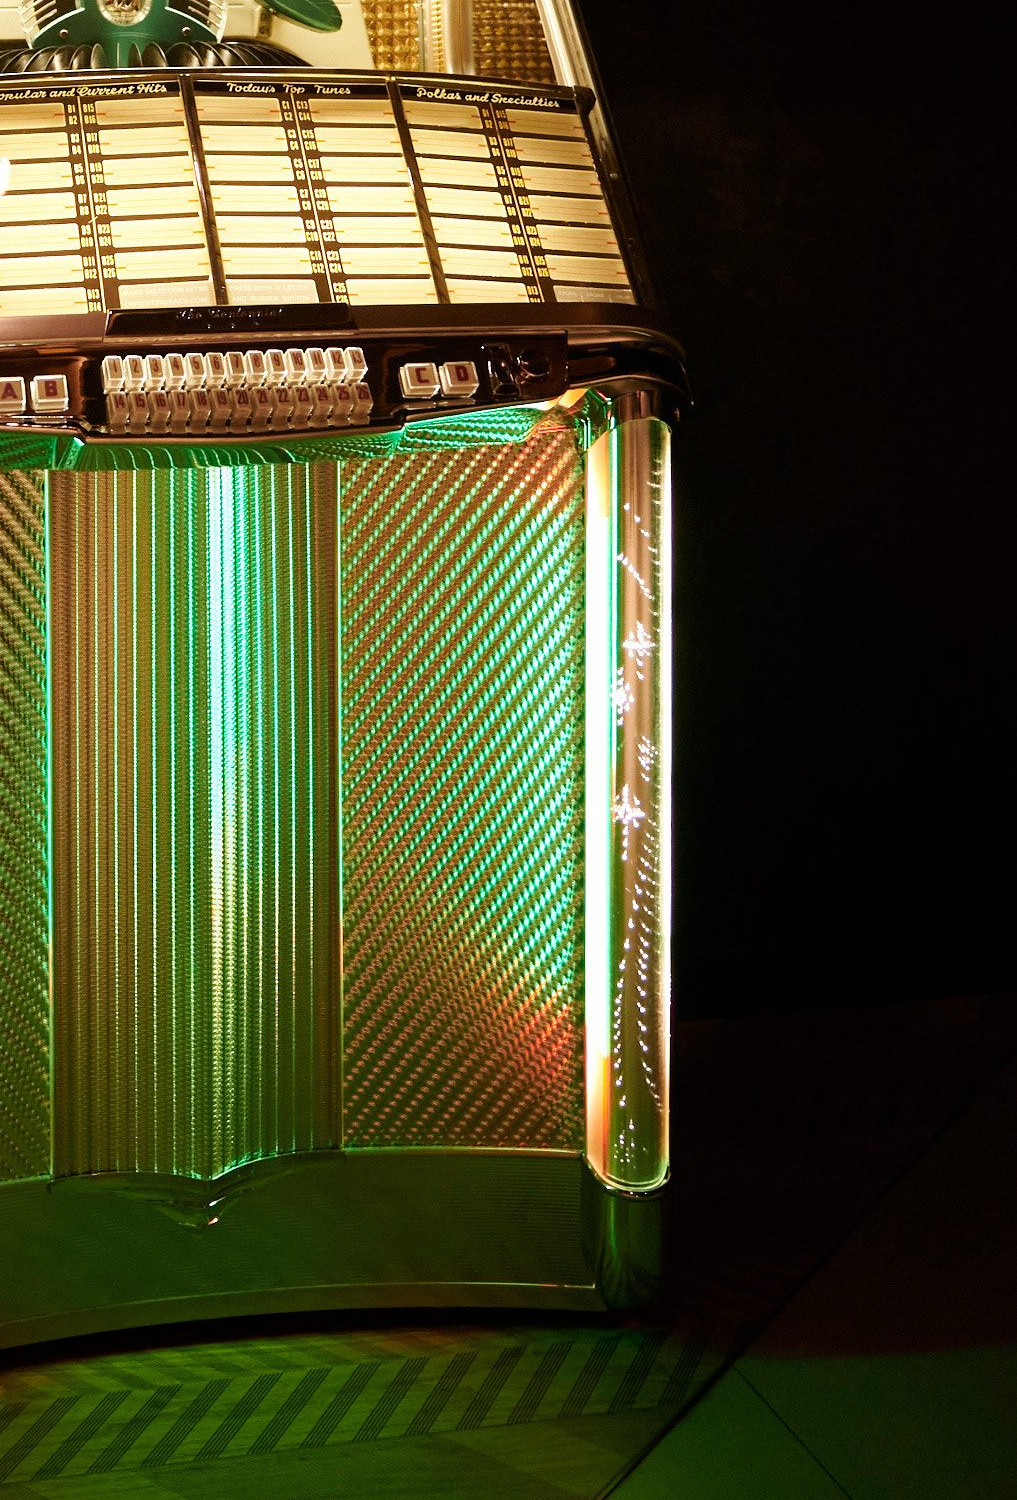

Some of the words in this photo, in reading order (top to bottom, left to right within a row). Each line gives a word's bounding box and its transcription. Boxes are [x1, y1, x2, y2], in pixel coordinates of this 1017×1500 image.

[49, 88, 75, 97] and
[77, 85, 135, 96] Current
[137, 84, 167, 94] Hits
[227, 83, 275, 93] Today's
[283, 84, 305, 94] Top
[314, 85, 351, 94] Tunes
[416, 87, 462, 100] Polkas
[465, 92, 489, 102] and
[491, 94, 560, 108] Specialties
[68, 105, 75, 113] B1
[83, 104, 94, 112] B15
[282, 101, 289, 109] C1
[296, 101, 308, 109] C13
[69, 116, 77, 124] B2
[84, 115, 96, 124] B16
[284, 112, 293, 121] C2
[299, 112, 310, 120] C14
[71, 134, 79, 143] B3
[86, 133, 97, 142] B17
[287, 129, 296, 138] C3
[302, 130, 314, 139] C15
[72, 145, 81, 154] B4
[290, 141, 299, 150] C4
[304, 141, 316, 150] C16
[74, 164, 83, 173] B5
[293, 159, 303, 168] C5
[308, 159, 319, 168] C17
[75, 175, 85, 185] B6
[78, 194, 87, 204] B7
[94, 193, 106, 203] B21
[95, 205, 107, 215] B22
[81, 237, 93, 247] B10
[101, 255, 114, 265] B25
[310, 251, 322, 260] C11
[83, 256, 95, 267] B11
[103, 268, 116, 278] B26
[312, 263, 324, 273] C12
[85, 269, 97, 279] B12
[87, 289, 100, 299] B13
[89, 302, 101, 312] B14
[193, 356, 199, 369] 5
[214, 356, 220, 369] 6
[234, 356, 239, 368] 7
[254, 354, 260, 367] 8
[274, 353, 280, 366] 9
[292, 353, 303, 365] 10
[313, 351, 322, 364] 11
[332, 351, 343, 364] 12
[352, 351, 362, 363] 13
[113, 361, 117, 372] 1
[132, 361, 139, 373] 2
[152, 360, 158, 372] 3
[173, 358, 179, 370] 4
[415, 368, 429, 383] C
[455, 366, 469, 382] D
[2, 382, 18, 399] A
[44, 380, 57, 397] B
[316, 387, 328, 401] 24
[336, 386, 350, 400] 25
[356, 385, 369, 399] 26
[196, 393, 207, 406] 18
[217, 393, 227, 405] 19
[236, 391, 248, 404] 20
[257, 390, 267, 403] 21
[276, 389, 289, 402] 22
[296, 388, 309, 401] 23
[115, 397, 124, 408] 14
[135, 396, 145, 407] 15
[155, 395, 165, 407] 16
[177, 394, 185, 407] 17
